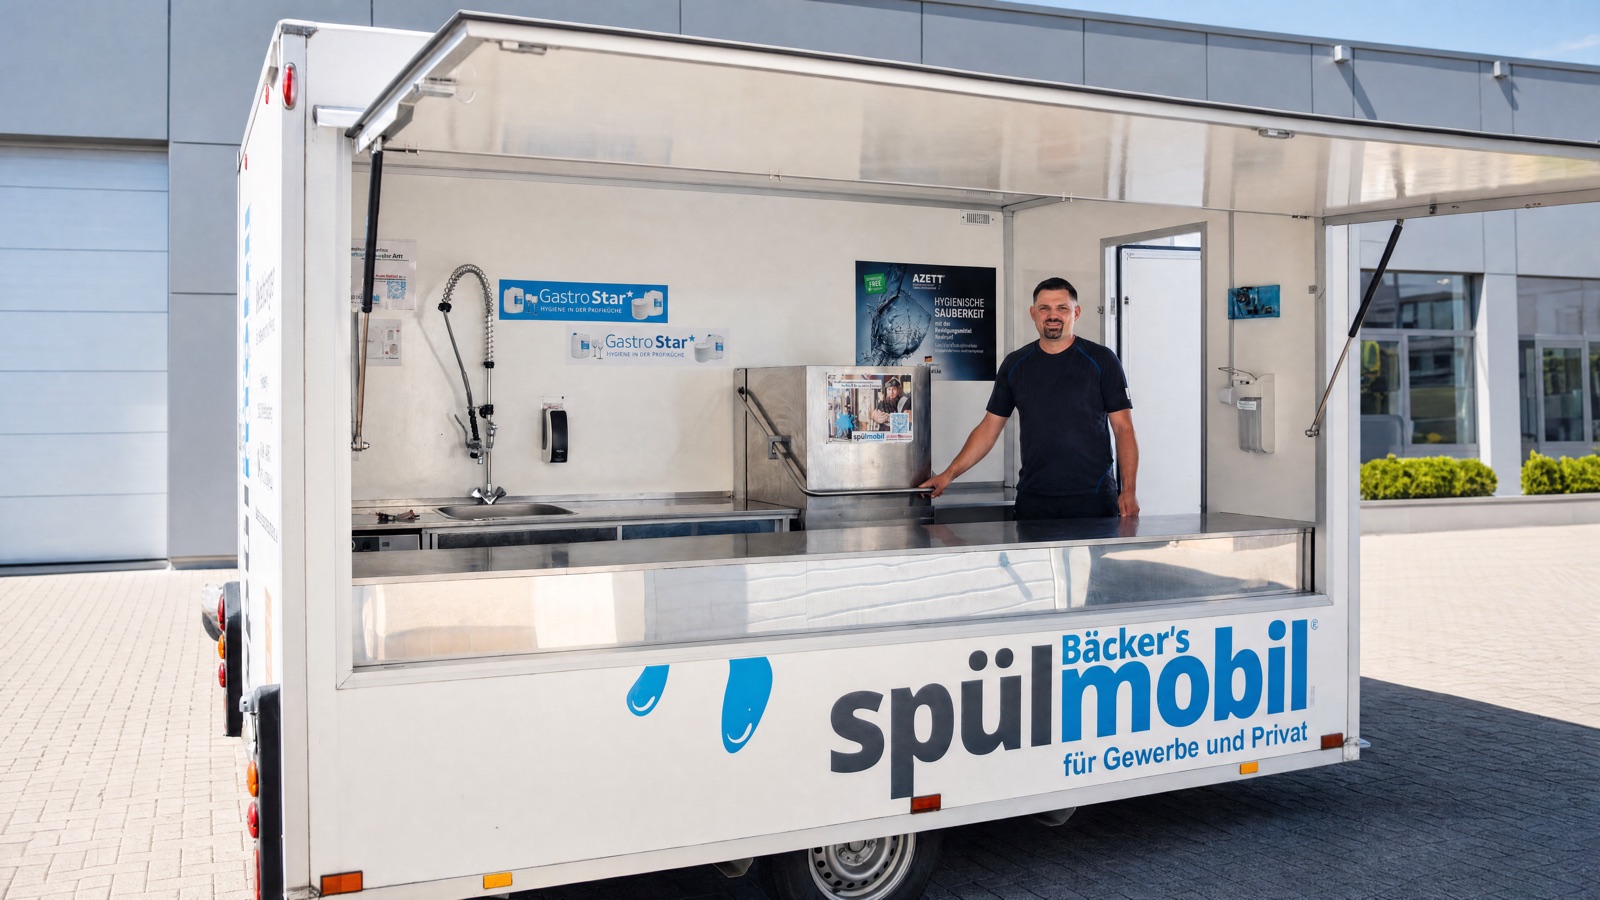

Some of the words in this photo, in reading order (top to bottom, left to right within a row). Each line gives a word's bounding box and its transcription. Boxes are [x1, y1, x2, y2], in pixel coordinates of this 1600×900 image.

[912, 273, 943, 283] AZETT
[539, 288, 590, 305] Gastro
[934, 297, 985, 308] HYGIENISCHE
[934, 308, 985, 319] SAUBERKEIT
[605, 334, 654, 349] Gastro
[853, 433, 885, 442] spülmobil
[1061, 625, 1190, 665] Bäcker's
[1063, 752, 1097, 777] für
[1103, 739, 1199, 771] Gewerbe
[1206, 729, 1246, 756] und
[1251, 721, 1309, 747] Privat
